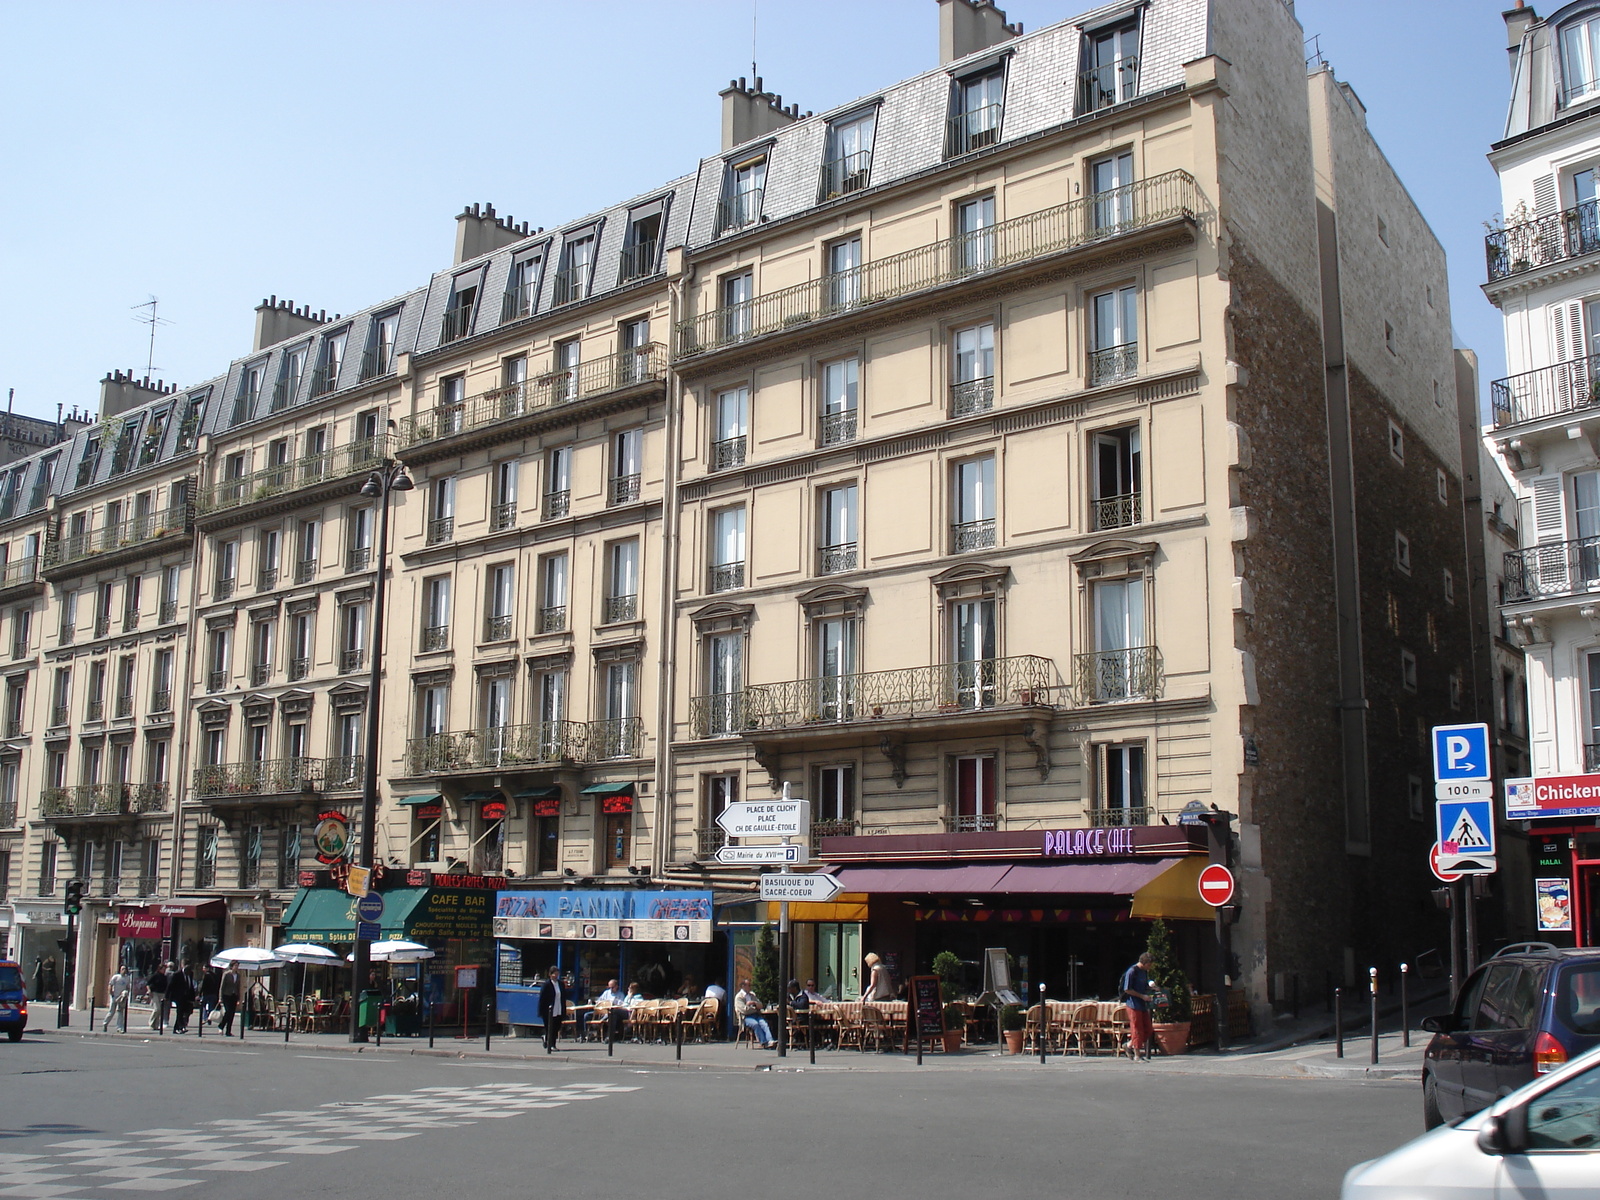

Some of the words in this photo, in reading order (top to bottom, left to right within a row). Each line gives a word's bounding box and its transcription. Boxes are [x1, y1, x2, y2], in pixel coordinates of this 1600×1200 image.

[1446, 736, 1470, 769] P
[1447, 786, 1469, 795] 100
[1536, 783, 1600, 800] Chicken
[1045, 829, 1104, 855] PALACE
[1107, 828, 1133, 853] CAFE
[488, 877, 507, 889] PIZZA
[764, 879, 802, 887] BASILIQUE
[764, 887, 813, 896] SACRÉ-COEUR
[431, 894, 458, 905] CAFE
[464, 896, 486, 906] BAR
[160, 904, 186, 916] Benjamin
[496, 896, 546, 918] PIZZAS
[559, 896, 635, 918] PANINI
[122, 909, 158, 934] Benjamin
